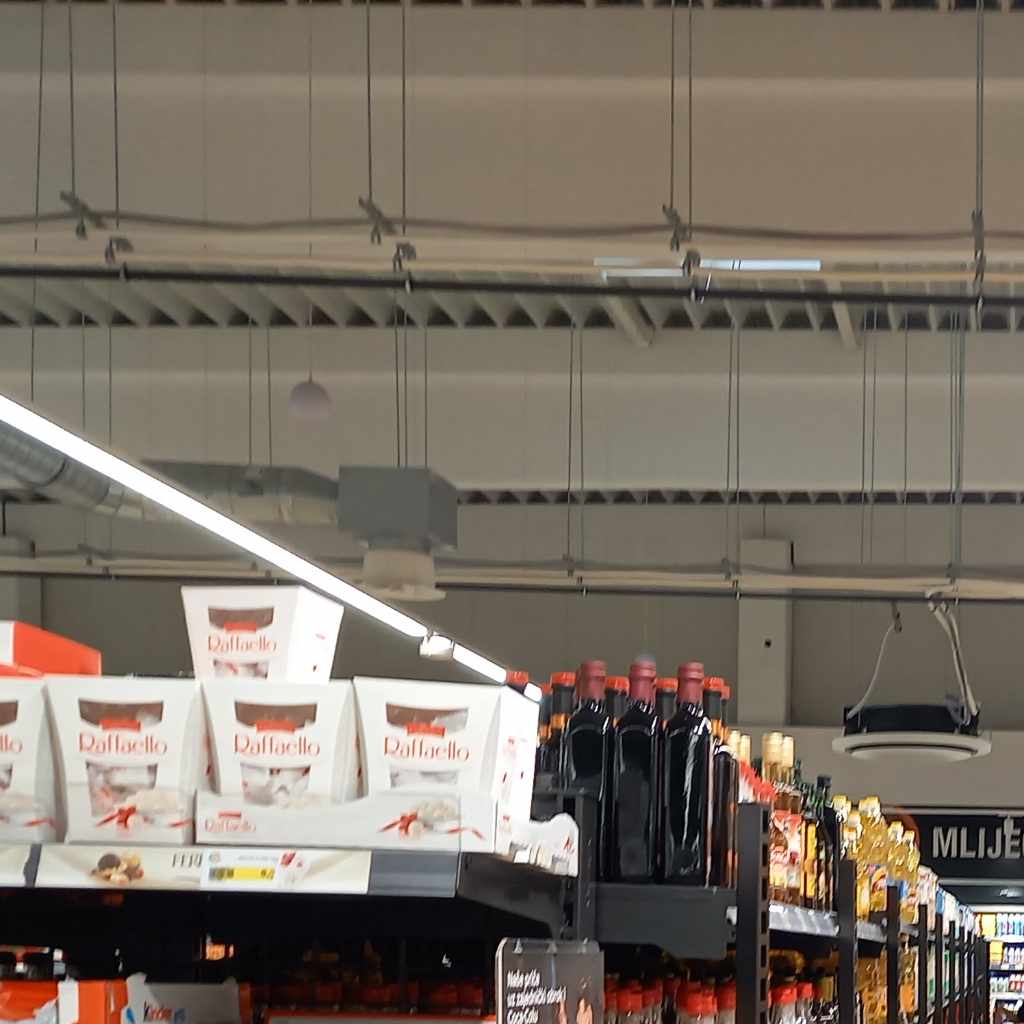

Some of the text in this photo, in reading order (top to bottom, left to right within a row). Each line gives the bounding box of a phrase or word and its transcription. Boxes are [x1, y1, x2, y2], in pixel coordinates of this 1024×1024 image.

[207, 634, 278, 653] Raffaello
[79, 733, 168, 754] Raffaello
[233, 734, 320, 757] Raffaello
[384, 736, 470, 762] Raffaello
